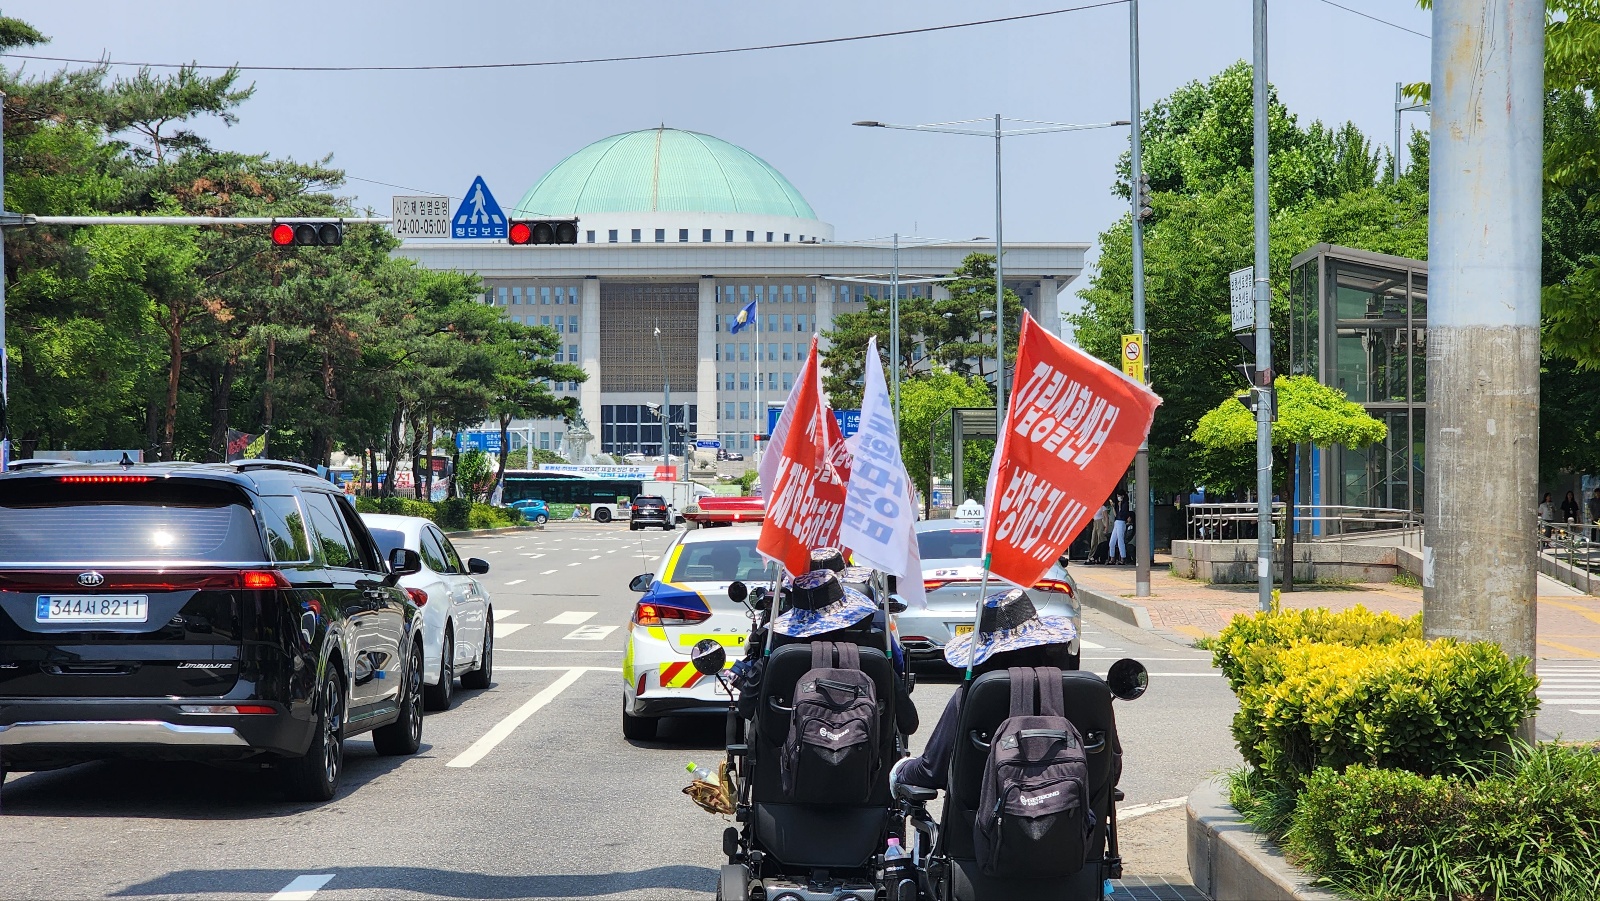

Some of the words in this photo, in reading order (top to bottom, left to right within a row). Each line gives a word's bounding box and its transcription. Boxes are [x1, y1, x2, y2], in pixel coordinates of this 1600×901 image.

[395, 202, 416, 216] 시간제
[419, 201, 448, 216] 점멸운영
[397, 219, 447, 234] 24:00-05:00
[455, 227, 504, 237] 횡단보도
[1014, 361, 1120, 471] 자립생활센터
[962, 509, 981, 517] TAXI
[995, 466, 1067, 554] 보장하라
[79, 575, 101, 584] KIA
[51, 599, 96, 616] 344서
[100, 599, 141, 616] 8211
